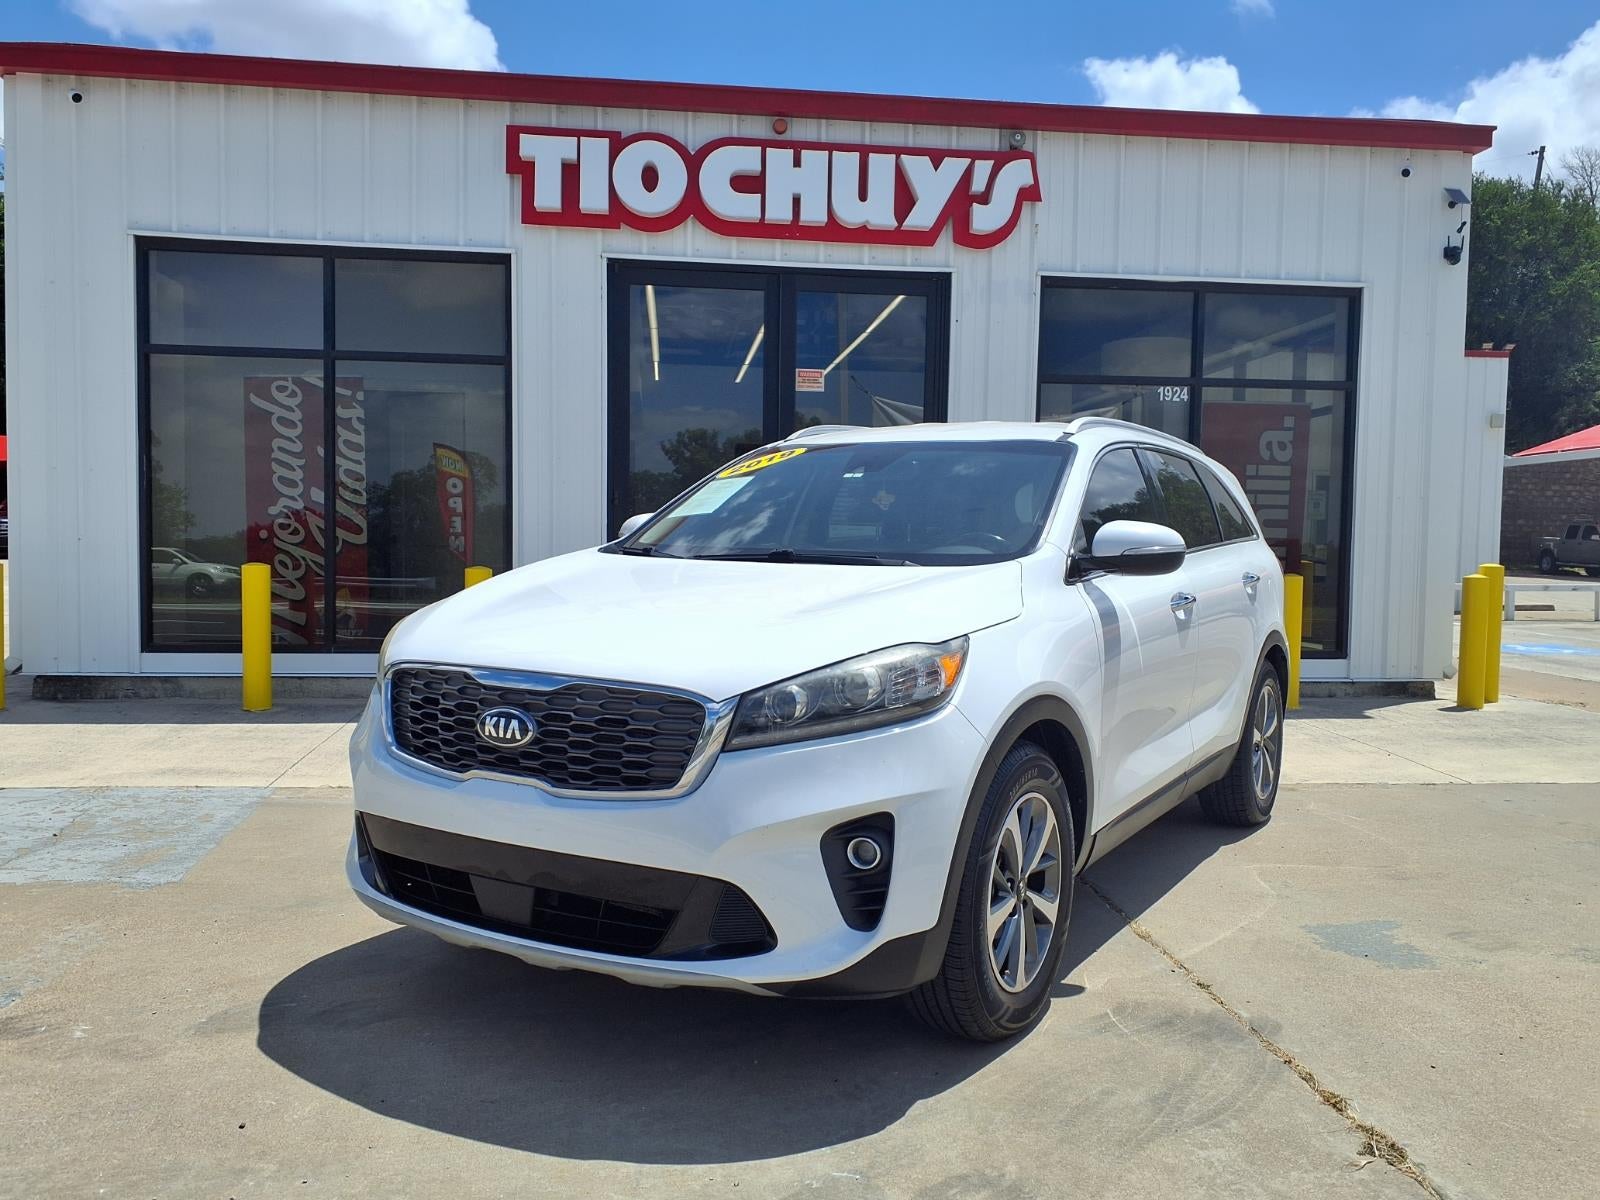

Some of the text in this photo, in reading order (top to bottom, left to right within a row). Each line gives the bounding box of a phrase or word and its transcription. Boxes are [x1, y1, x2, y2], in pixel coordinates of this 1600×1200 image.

[519, 133, 1035, 235] TIO CHUY'S
[1157, 386, 1189, 402] 1924
[484, 715, 522, 740] KIA
